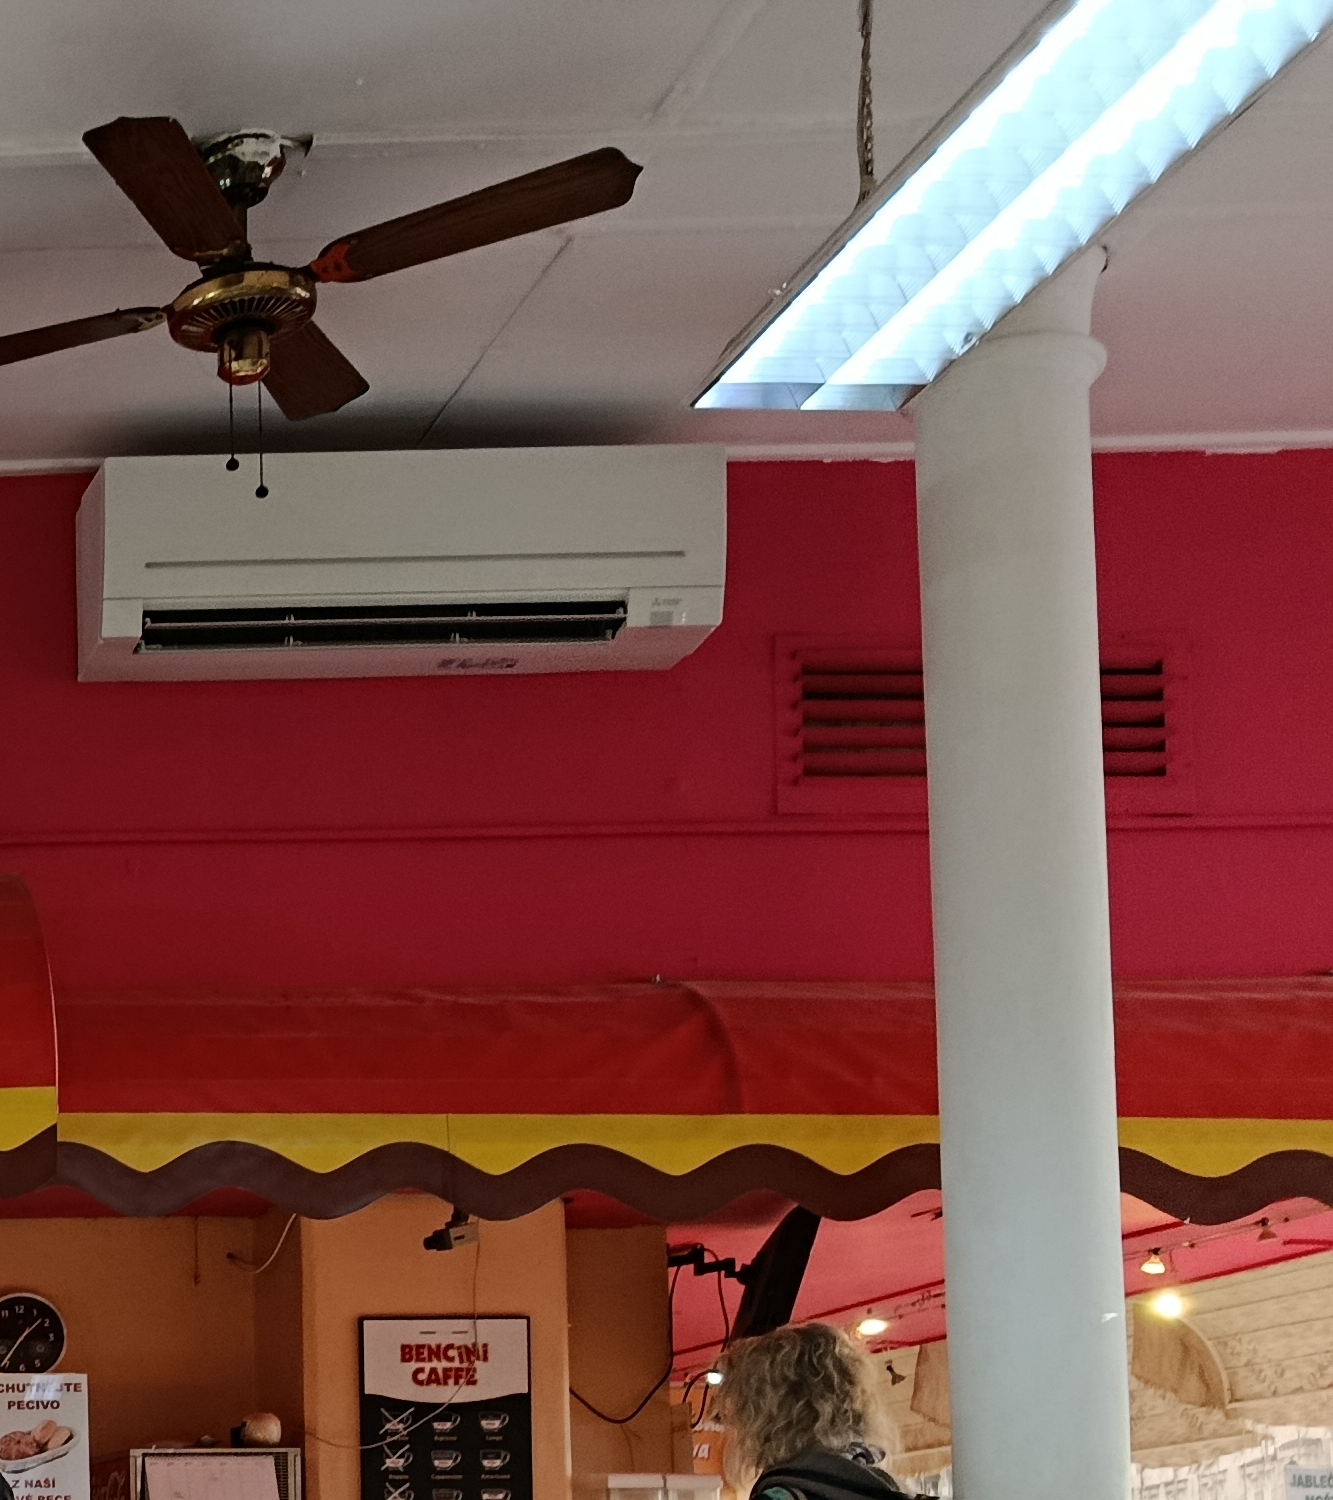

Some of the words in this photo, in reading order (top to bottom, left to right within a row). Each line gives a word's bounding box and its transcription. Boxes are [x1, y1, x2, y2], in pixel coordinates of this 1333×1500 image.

[15, 1305, 25, 1313] 12
[33, 1309, 37, 1317] 1
[1, 1310, 9, 1318] 11
[44, 1318, 50, 1327] 2
[48, 1333, 55, 1341] 3
[400, 1342, 489, 1364] BENCINI
